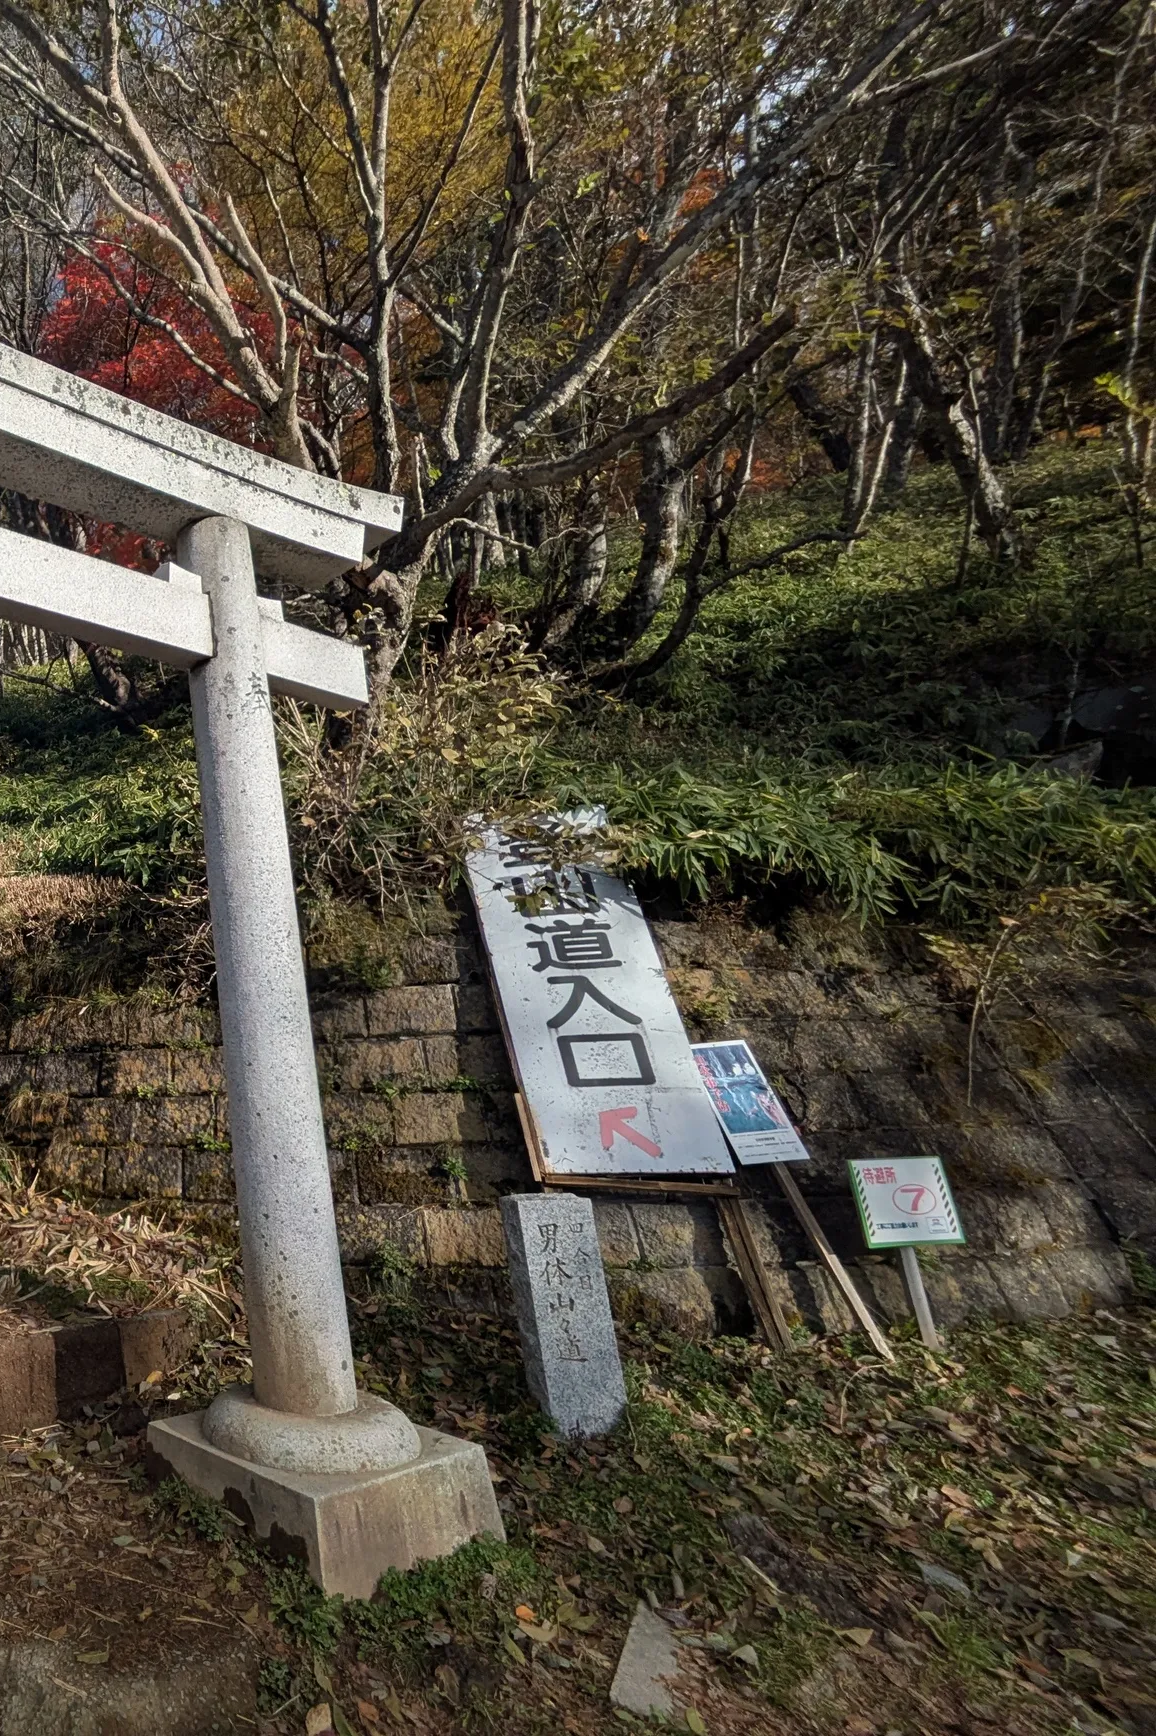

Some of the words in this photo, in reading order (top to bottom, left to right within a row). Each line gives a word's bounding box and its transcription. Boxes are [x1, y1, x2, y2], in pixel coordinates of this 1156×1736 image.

[862, 1166, 897, 1185] 待避所
[566, 1221, 593, 1291] 四合目
